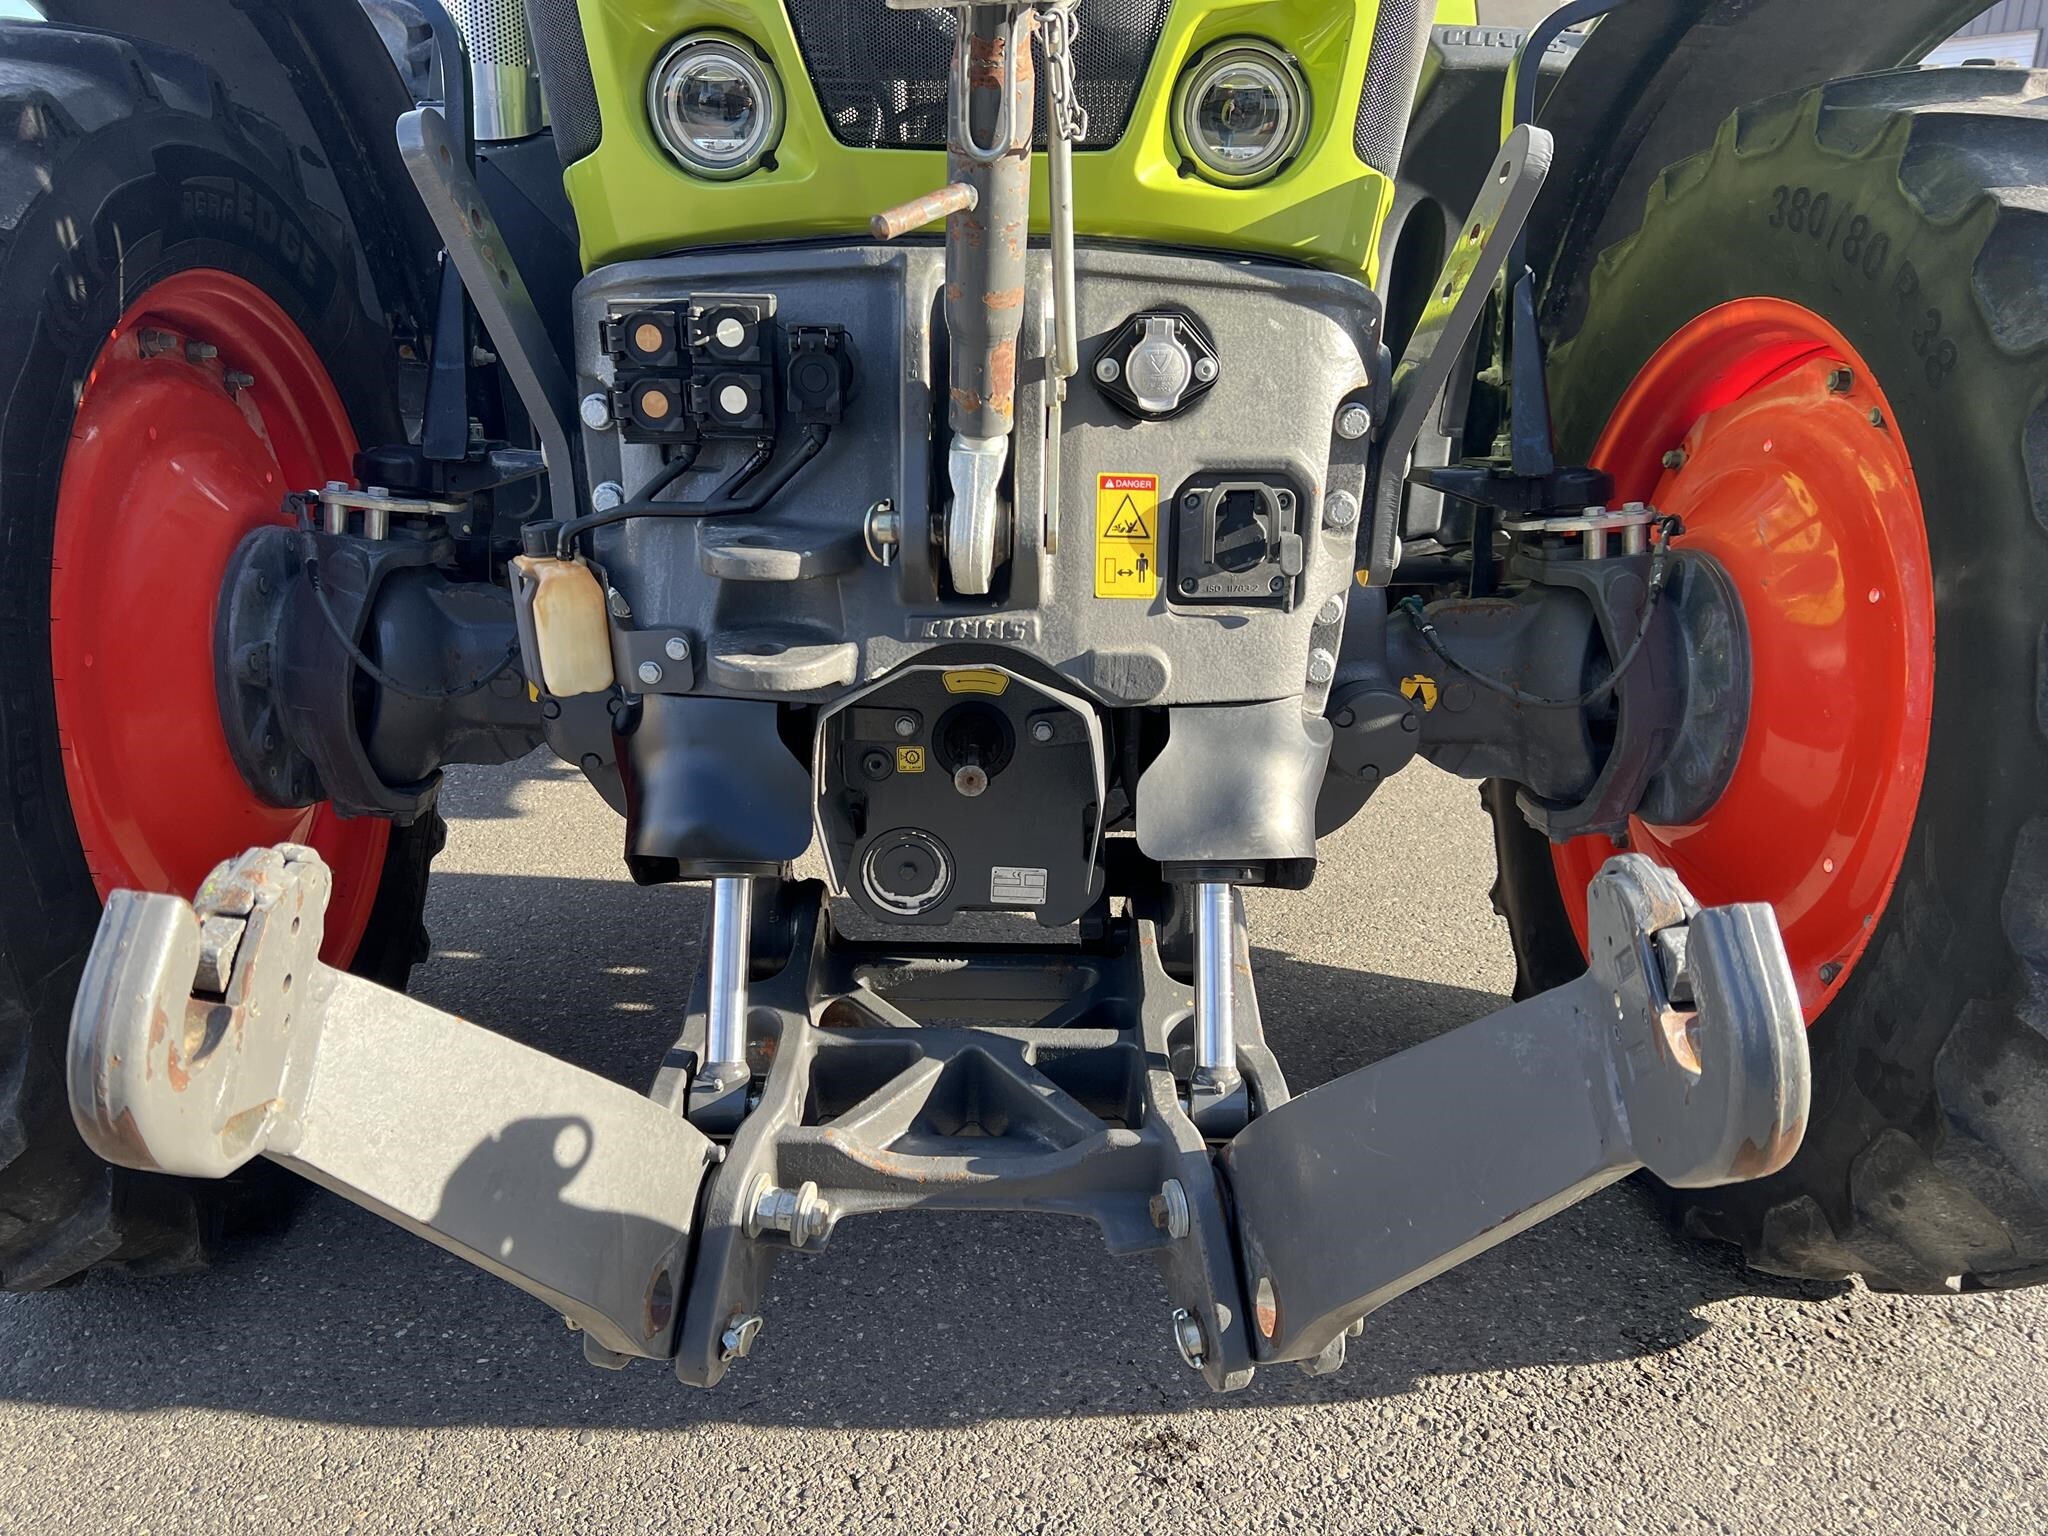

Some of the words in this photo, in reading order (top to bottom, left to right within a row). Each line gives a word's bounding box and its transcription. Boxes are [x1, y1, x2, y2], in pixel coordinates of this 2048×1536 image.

[1442, 30, 1568, 54] CLAS
[1769, 184, 1891, 281] 380/80
[1911, 307, 1958, 390] 38
[1115, 479, 1152, 489] DANGER
[1206, 584, 1223, 593] ISO
